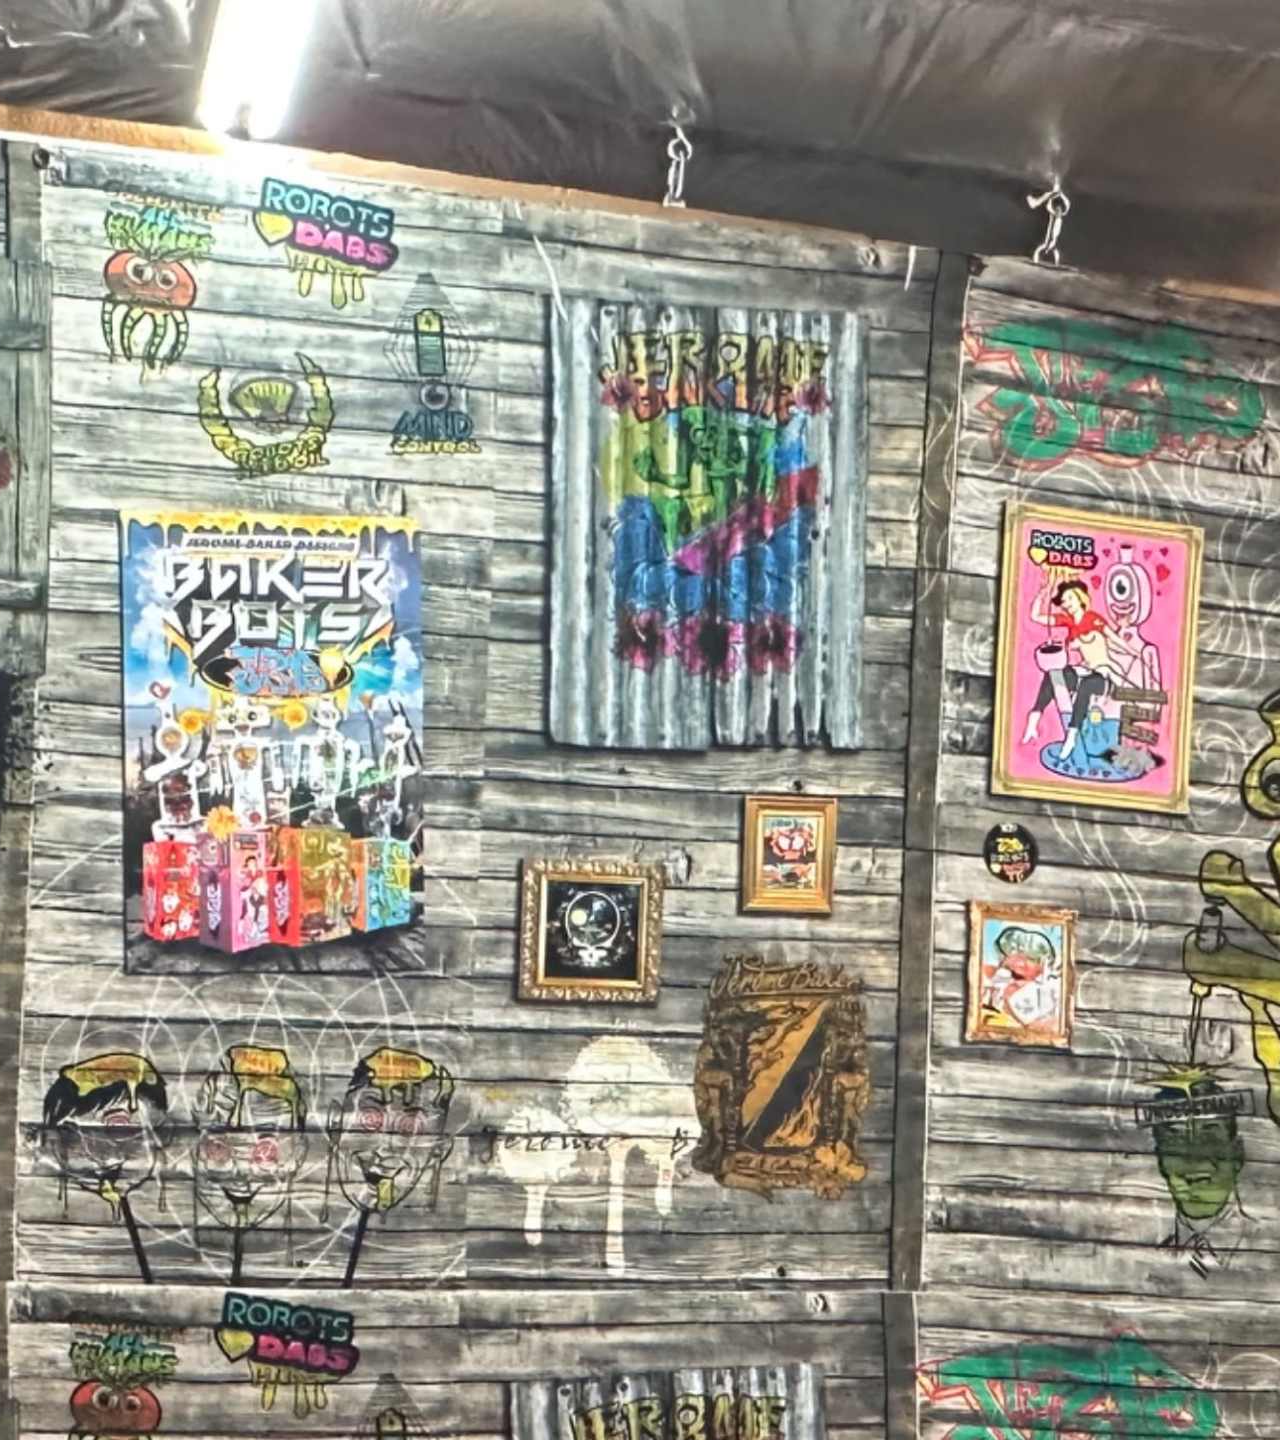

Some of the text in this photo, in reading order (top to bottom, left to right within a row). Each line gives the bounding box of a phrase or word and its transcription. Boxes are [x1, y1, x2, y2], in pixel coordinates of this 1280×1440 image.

[266, 181, 391, 239] ROBOTS
[295, 220, 391, 265] DABS
[392, 409, 474, 441] MIND
[1031, 533, 1093, 553] ROBOTS
[162, 553, 392, 608] BAKER
[186, 599, 366, 655] BOTS
[227, 1298, 351, 1342] ROBOTS
